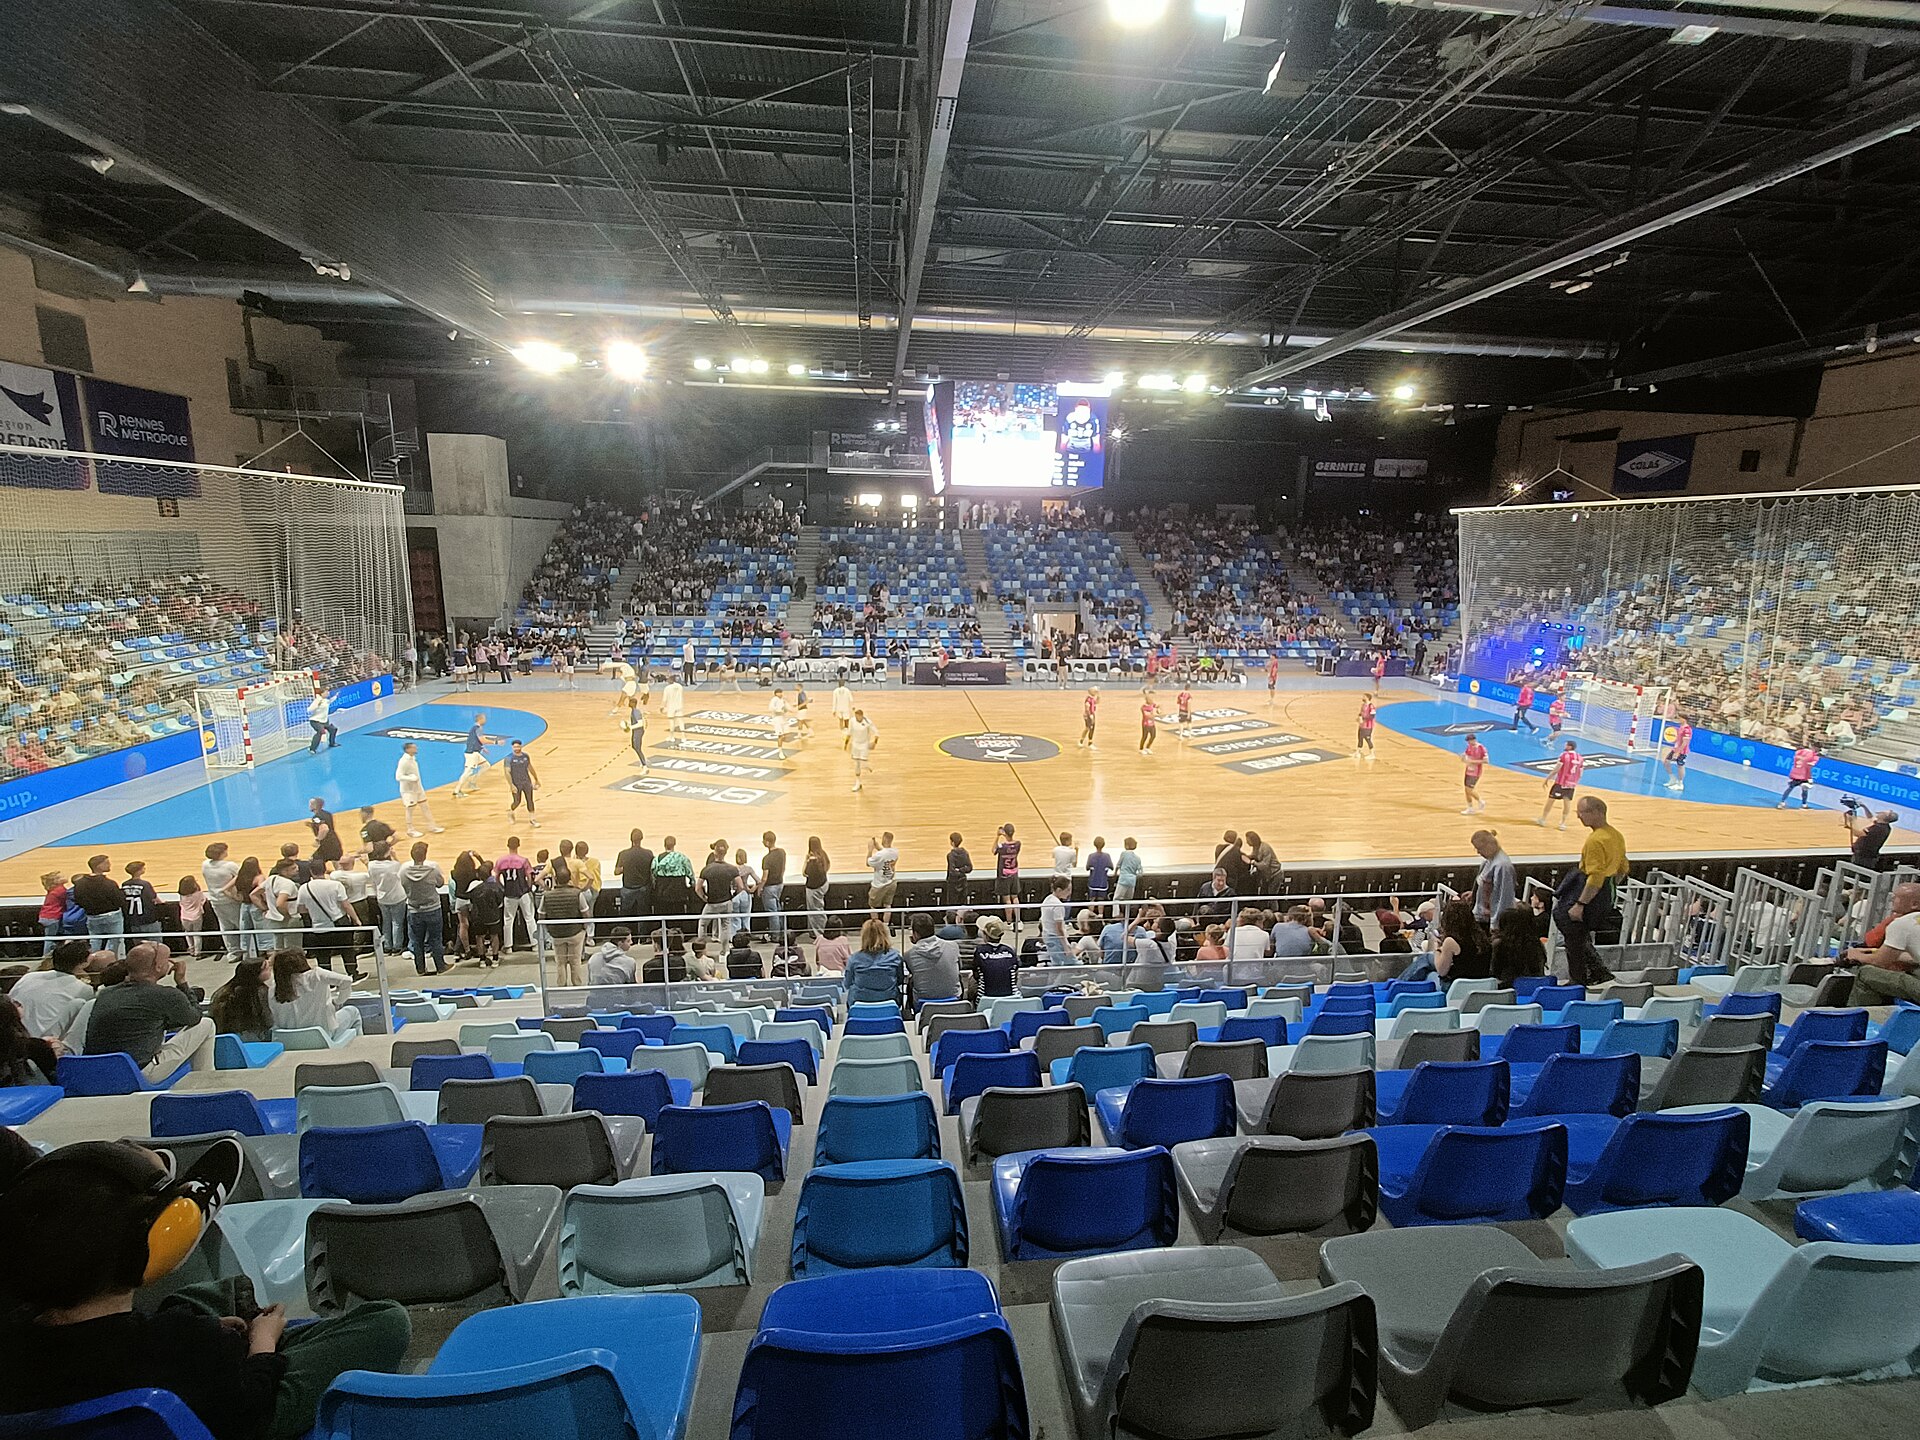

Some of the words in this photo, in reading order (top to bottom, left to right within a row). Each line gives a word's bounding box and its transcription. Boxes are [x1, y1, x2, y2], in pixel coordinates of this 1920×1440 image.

[1629, 459, 1660, 470] COLAS
[651, 758, 772, 778] LAUNAY
[1776, 754, 1839, 783] Mgez
[505, 868, 517, 881] 14
[125, 896, 143, 915] 71
